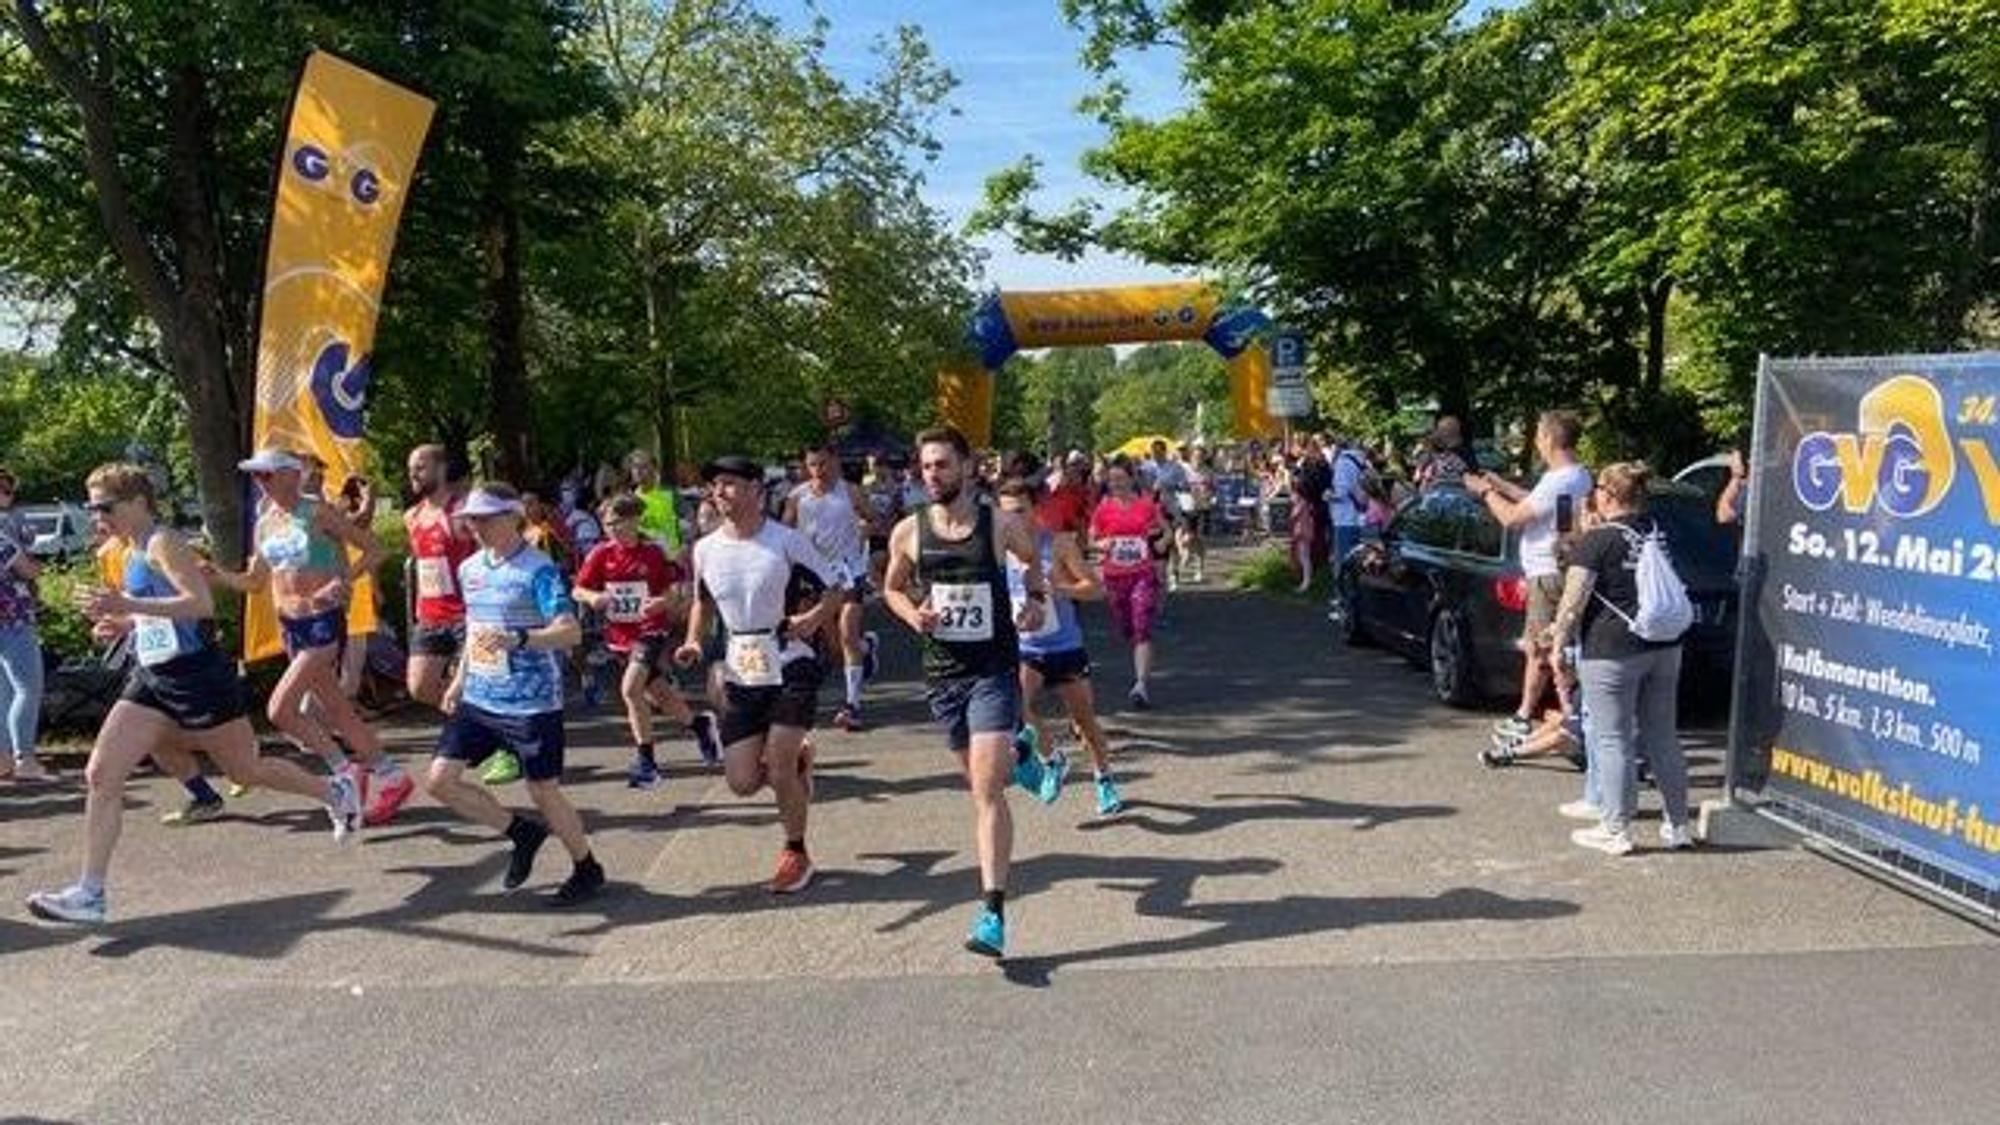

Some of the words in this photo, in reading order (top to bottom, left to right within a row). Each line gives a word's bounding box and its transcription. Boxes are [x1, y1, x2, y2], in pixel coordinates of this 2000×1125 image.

[1278, 337, 1297, 364] P
[1794, 431, 1955, 518] GVG
[1788, 522, 1836, 560] So.
[1843, 528, 1891, 567] 12.
[1894, 534, 1964, 577] Mai
[1967, 542, 2000, 582] 2
[941, 606, 983, 629] 373
[1784, 584, 1816, 614] Start
[1783, 644, 1937, 707] Halbmarathon.
[1824, 694, 1837, 720] 5
[1871, 706, 1895, 740] 1,3
[1930, 722, 1962, 760] 500
[1962, 737, 1981, 766] m
